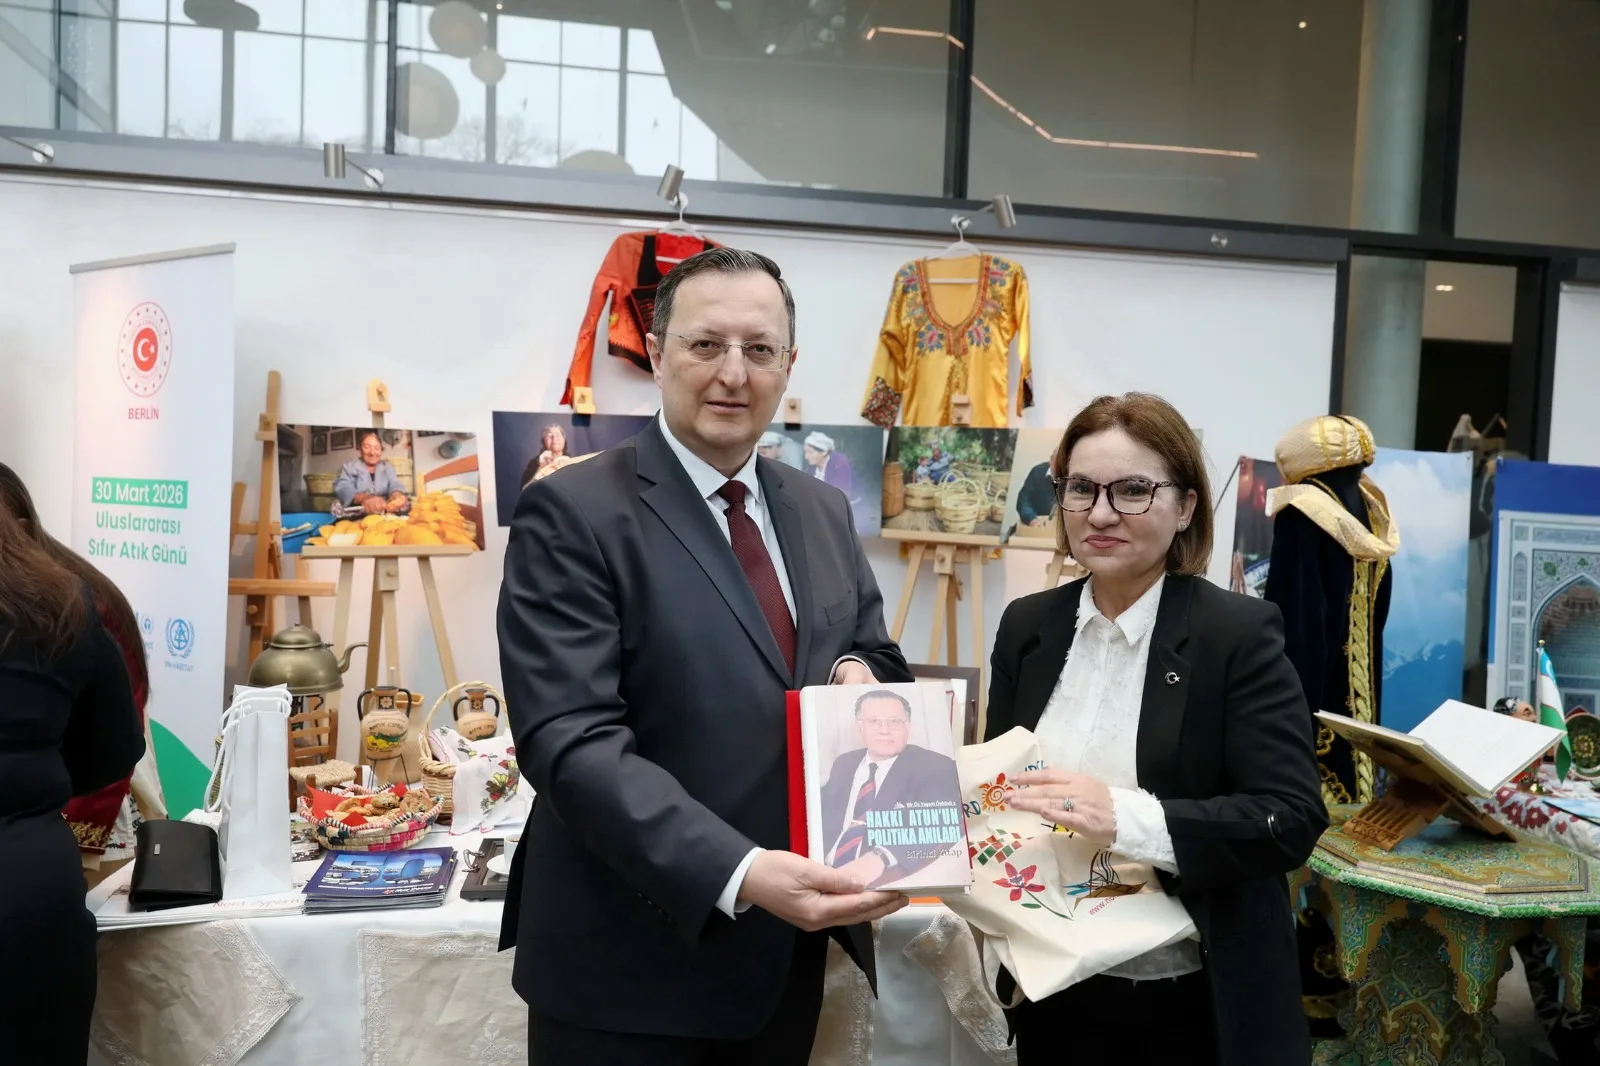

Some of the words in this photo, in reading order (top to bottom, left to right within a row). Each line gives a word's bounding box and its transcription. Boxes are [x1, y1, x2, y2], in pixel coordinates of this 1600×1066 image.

[128, 406, 160, 420] BERLİN
[95, 481, 112, 501] 30
[115, 483, 150, 503] Mart
[152, 483, 184, 505] 2026
[96, 510, 181, 535] Uluslararası
[88, 538, 116, 557] Sıfır
[119, 541, 149, 560] Atık
[151, 544, 187, 565] Günü
[866, 810, 904, 828] HAKKI
[909, 808, 959, 827] ATUN'UN
[918, 825, 961, 845] ANILARI
